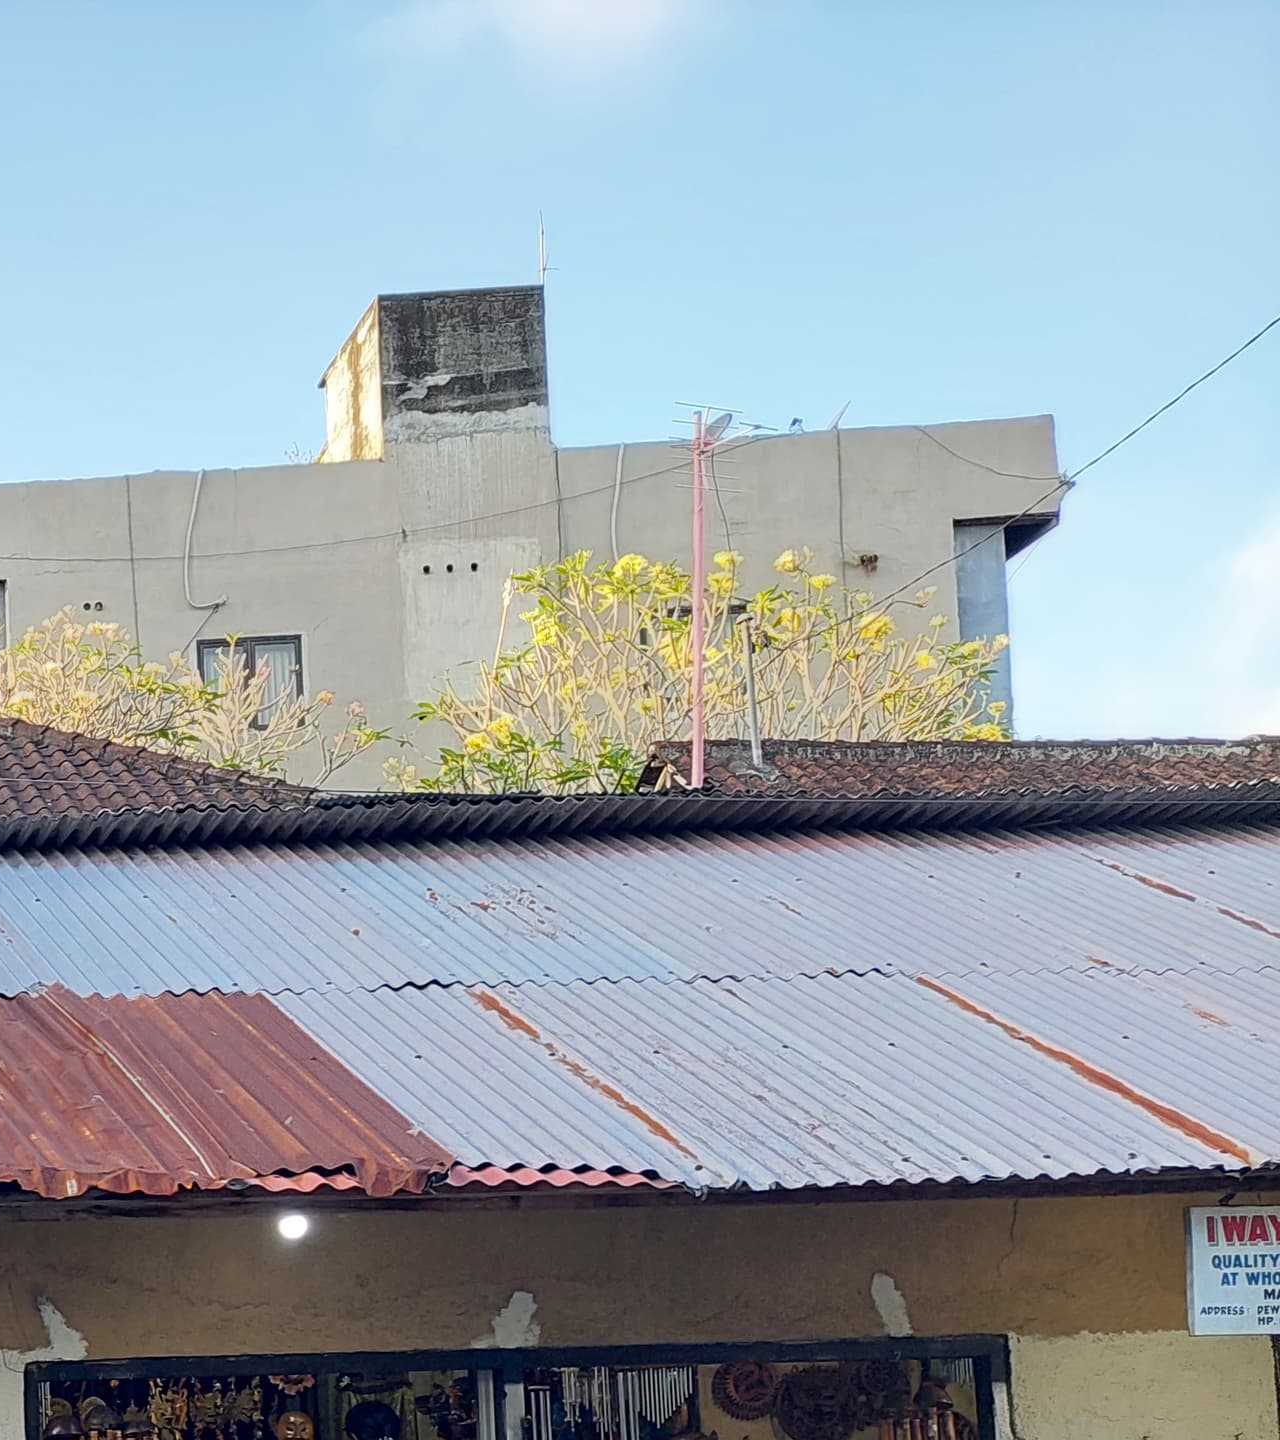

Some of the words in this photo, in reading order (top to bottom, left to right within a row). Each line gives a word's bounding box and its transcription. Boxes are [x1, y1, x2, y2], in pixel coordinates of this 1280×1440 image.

[1206, 1215, 1218, 1245] I
[1211, 1253, 1280, 1270] QUALITY
[1220, 1272, 1239, 1286] AT
